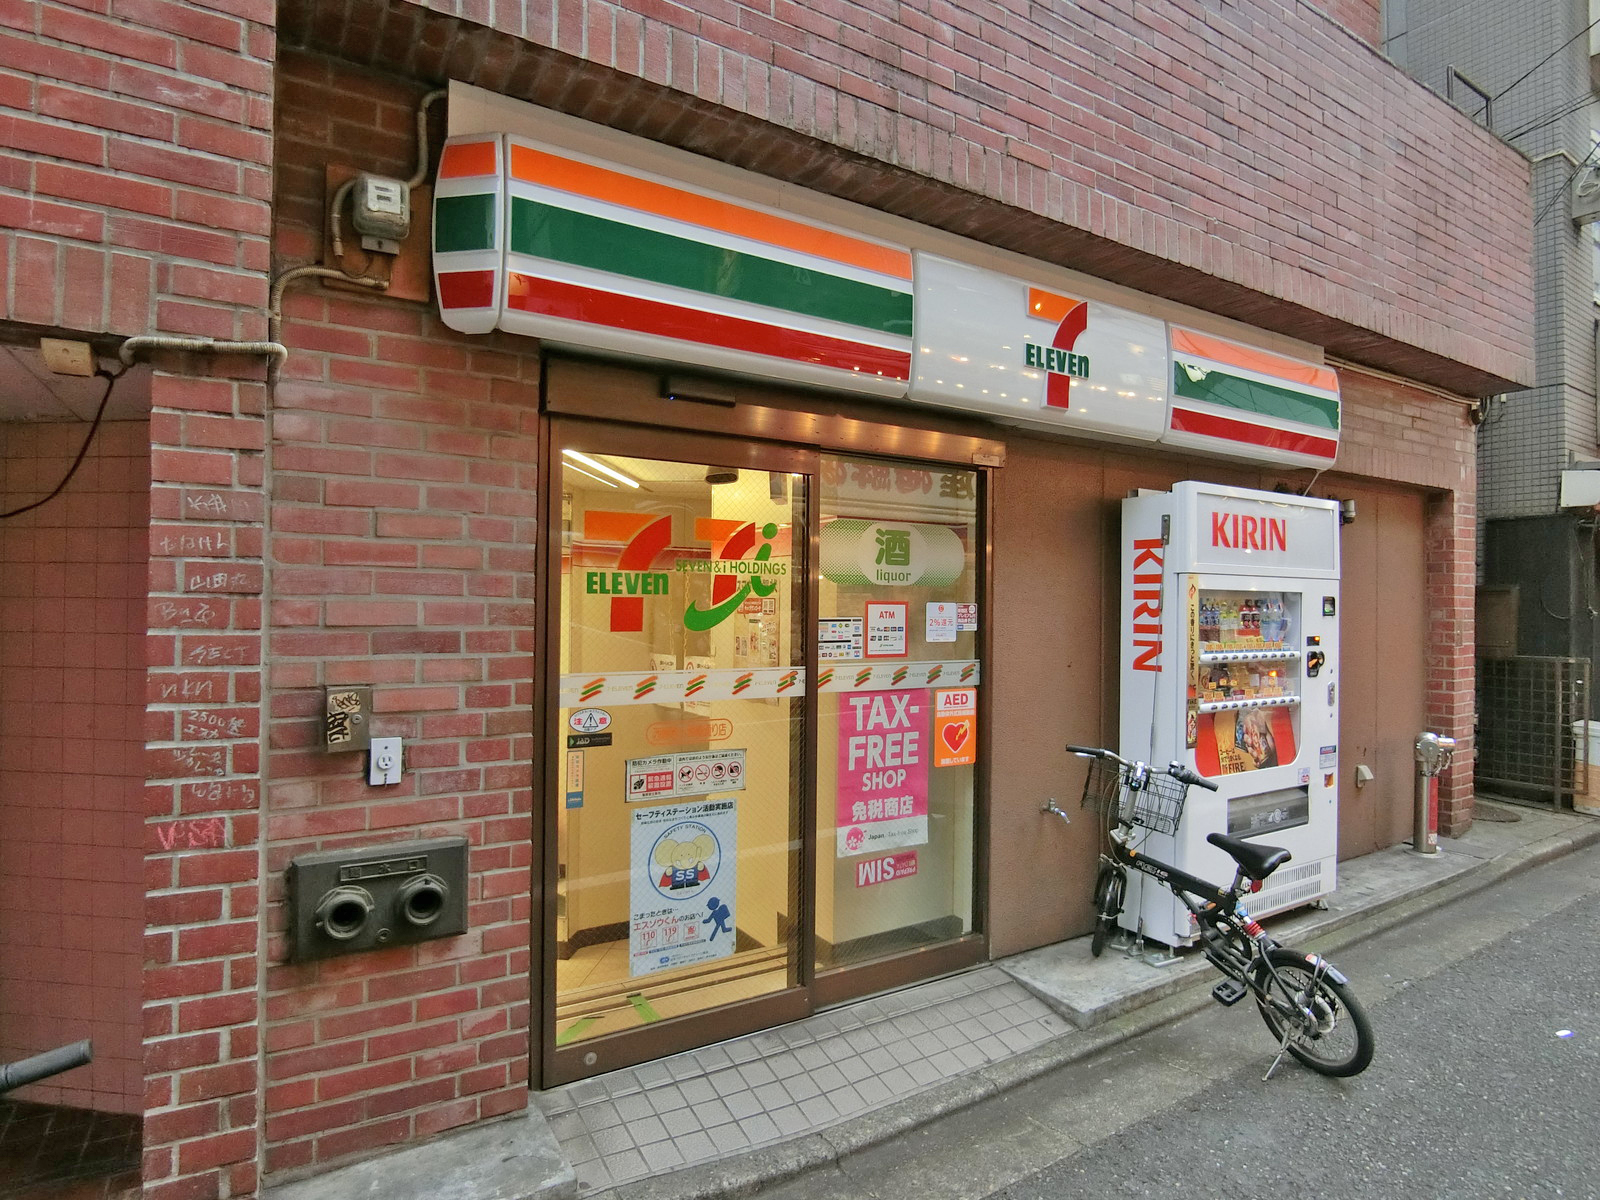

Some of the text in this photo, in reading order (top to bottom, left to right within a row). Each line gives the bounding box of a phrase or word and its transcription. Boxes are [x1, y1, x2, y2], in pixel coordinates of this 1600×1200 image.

[1211, 511, 1287, 552] KIRIN
[875, 528, 911, 567] 酒
[729, 561, 787, 575] HOLDINGS
[876, 569, 911, 583] liquor
[1132, 538, 1164, 673] KIRIN
[878, 611, 896, 619] ATM
[944, 693, 969, 706] AED
[849, 694, 920, 731] TAX-
[572, 717, 583, 726] 注
[848, 731, 920, 771] FREE
[861, 769, 907, 792] SHOP
[635, 801, 734, 820] セーフティステーション活動実施店
[852, 795, 914, 822] 免税商店
[663, 823, 707, 839] SAFETY STATION
[675, 869, 696, 881] SS
[642, 927, 677, 941] 110 119
